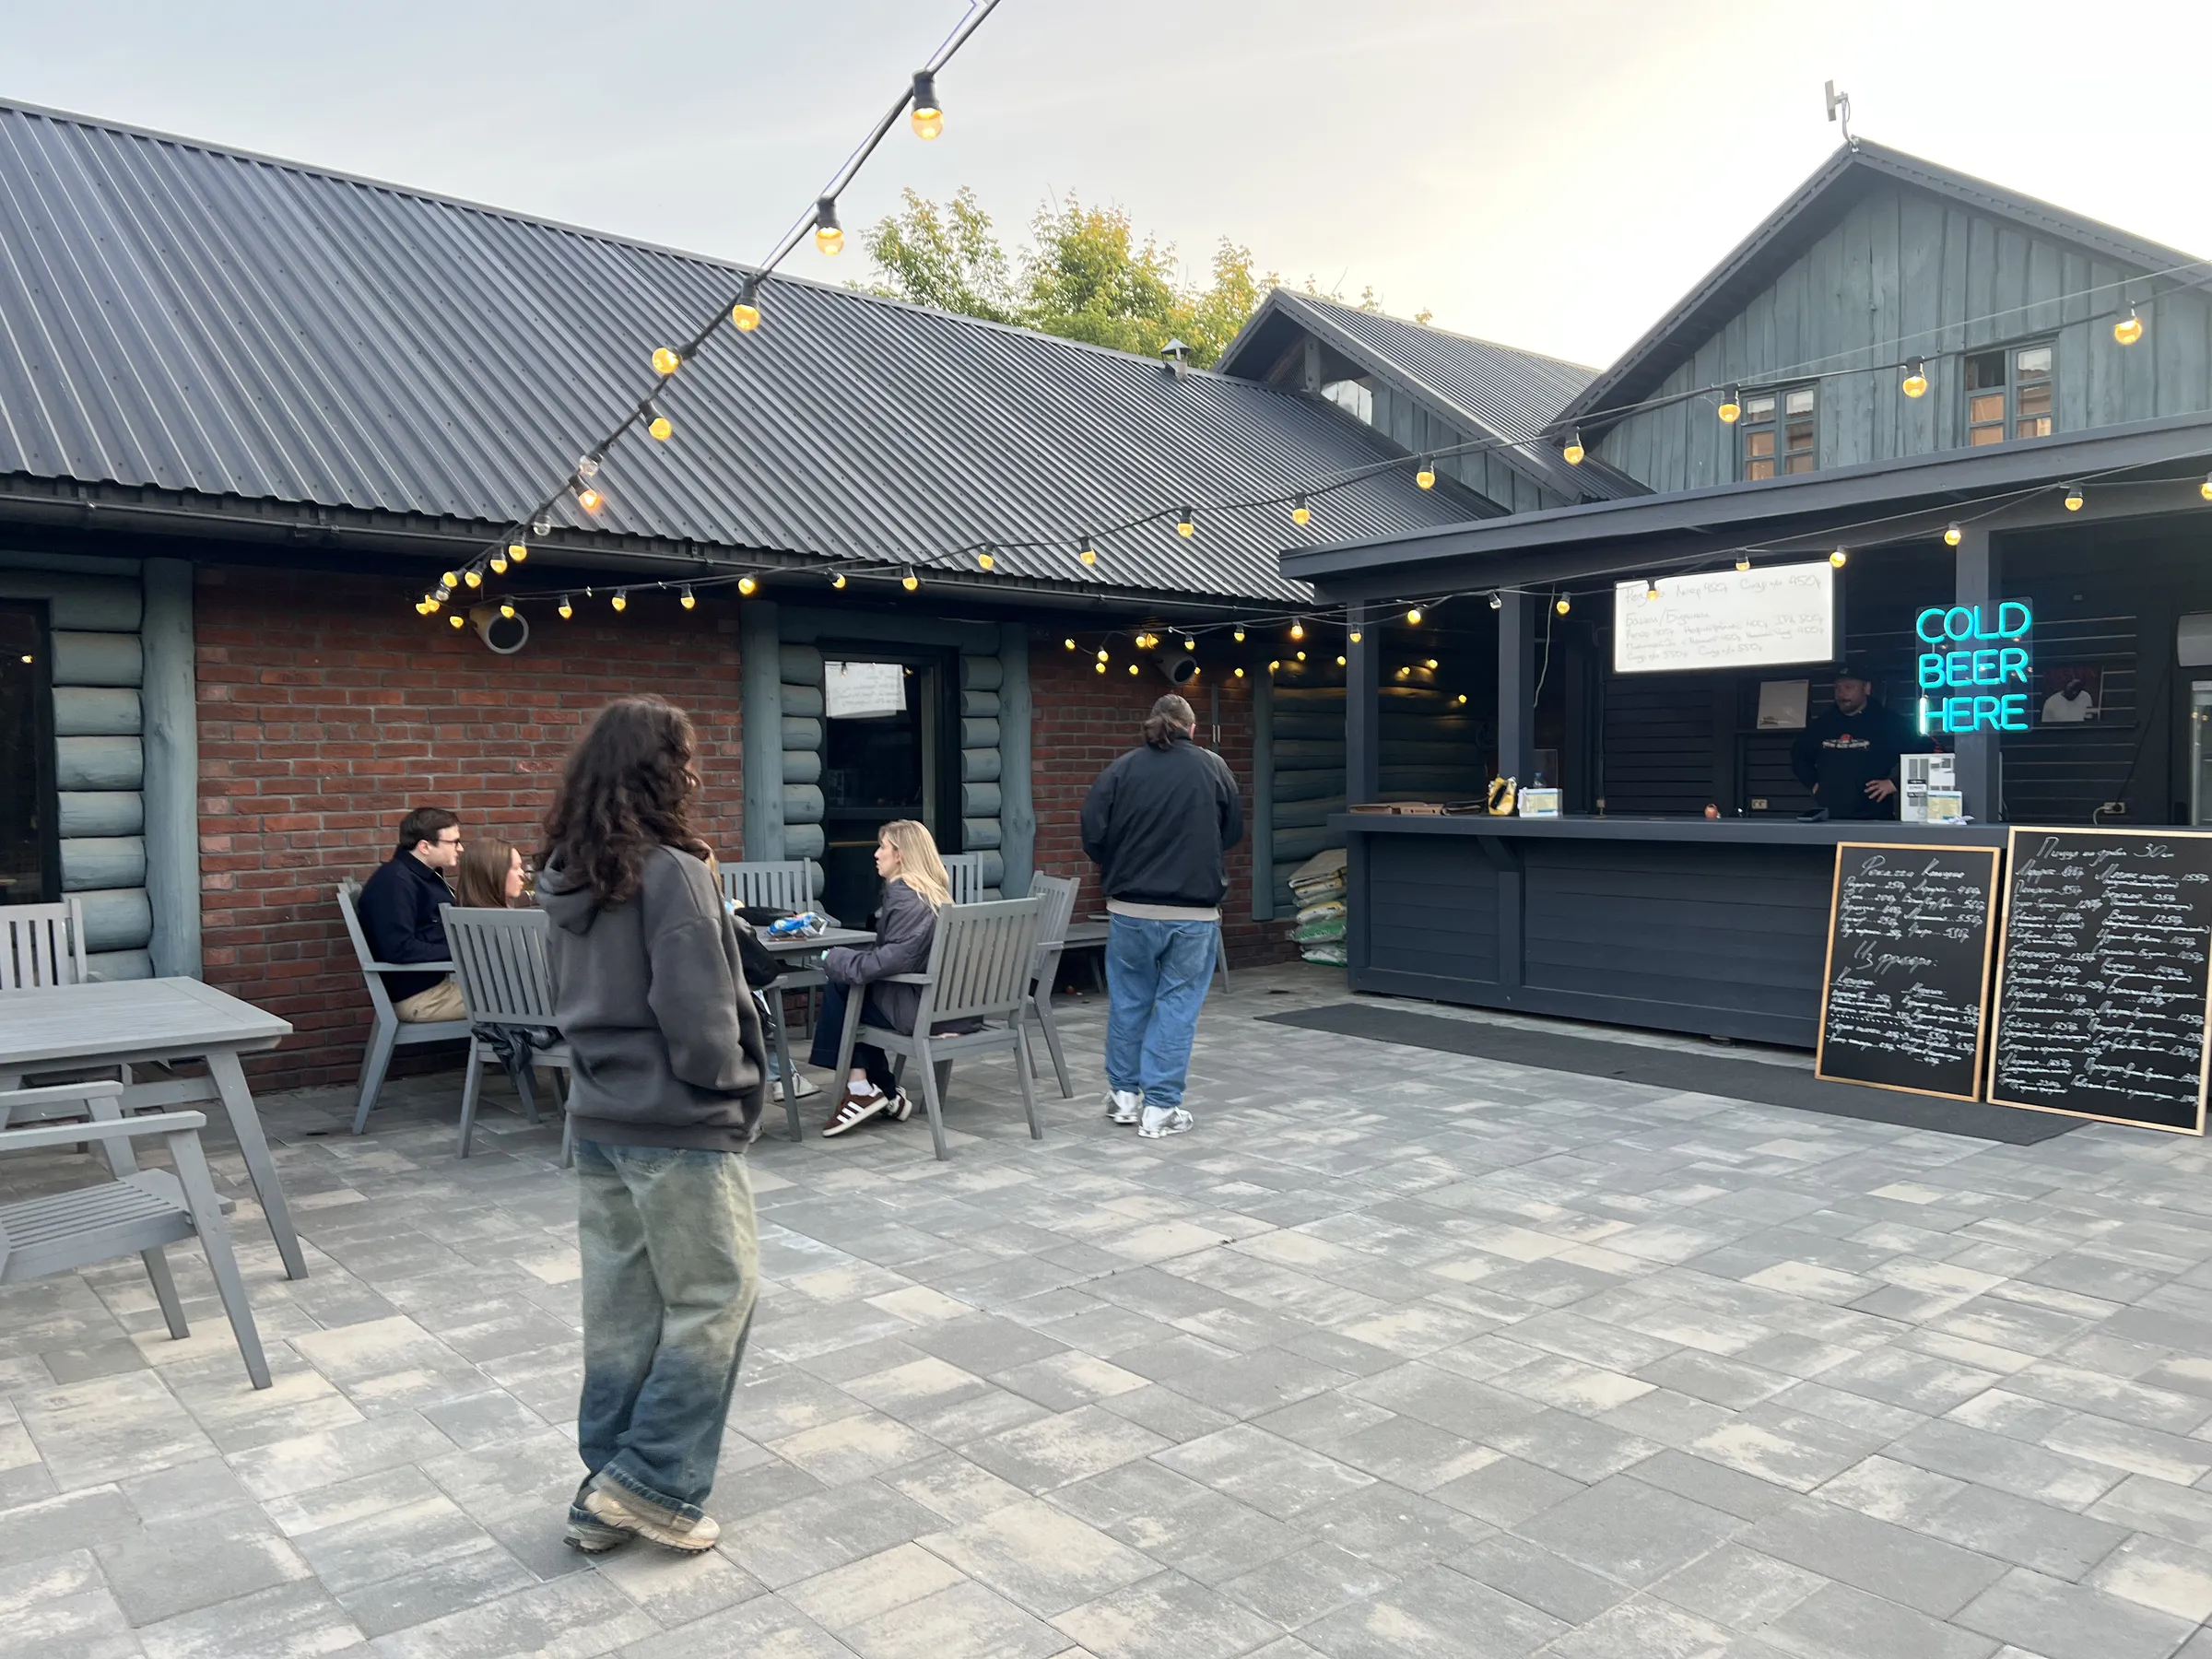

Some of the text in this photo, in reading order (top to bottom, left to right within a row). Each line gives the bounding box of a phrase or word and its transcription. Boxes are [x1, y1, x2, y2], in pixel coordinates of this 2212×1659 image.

[1625, 587, 1665, 607] Розв
[1789, 574, 1821, 590] 450р
[1916, 602, 2031, 643] COLD
[1918, 647, 2029, 688] BEER
[1918, 693, 2029, 735] HERE
